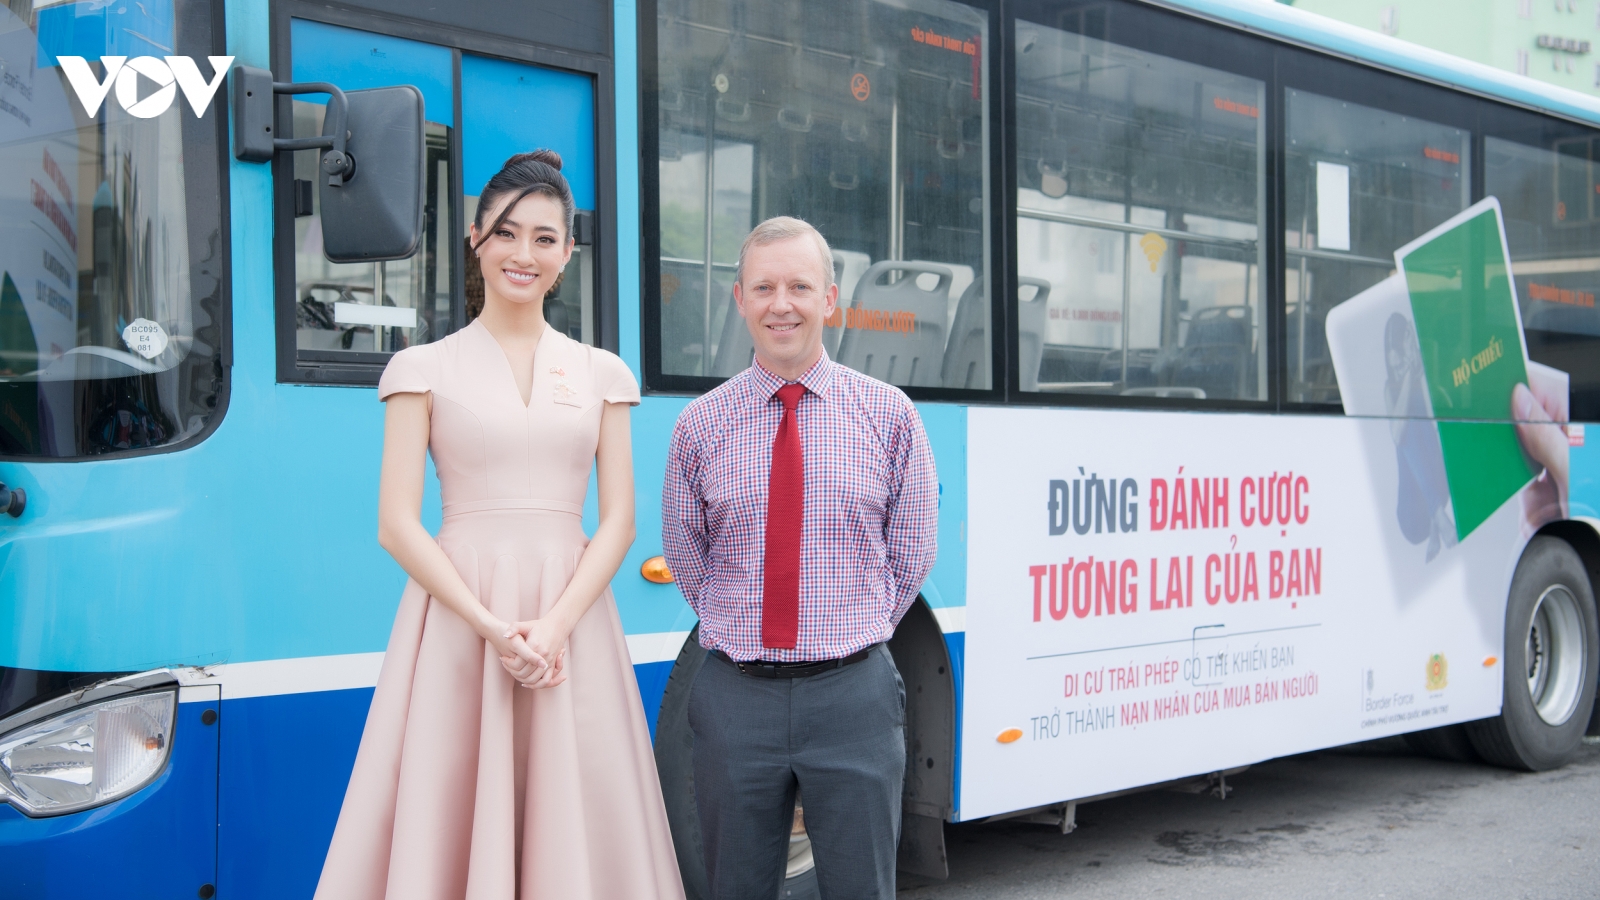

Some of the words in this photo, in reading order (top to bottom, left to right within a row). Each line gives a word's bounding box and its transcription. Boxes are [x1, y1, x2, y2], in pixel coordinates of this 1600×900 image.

[131, 325, 158, 333] BC095
[846, 301, 916, 338] ĐỒNG/LƯỢT
[1452, 358, 1471, 388] HỘ
[1470, 335, 1504, 375] CHIẾU
[1047, 466, 1138, 536] ĐỪNG
[1149, 465, 1229, 532] ĐÁNH
[1239, 471, 1310, 537] CƯỢC
[1029, 555, 1138, 623] TƯƠNG
[1149, 555, 1193, 611] LAI
[1204, 534, 1259, 606] CỦA
[1269, 547, 1322, 609] BẠN
[1064, 673, 1078, 698] DI
[1084, 666, 1104, 695] CƯ
[1108, 660, 1139, 691] TRÁI
[1145, 655, 1179, 687] PHÉP
[1183, 652, 1201, 681] CÓ
[1232, 642, 1267, 674] KHIẾN
[1271, 645, 1294, 672] BẠN
[1030, 706, 1061, 741] TRỞ
[1066, 702, 1115, 735] THÀNH
[1120, 700, 1149, 731] NẠN
[1154, 690, 1189, 721] NHÂN
[1194, 684, 1220, 714] CỦA
[1223, 685, 1250, 709] MUA
[1255, 677, 1278, 704] BÁN
[1282, 670, 1319, 700] NGƯỜI
[1365, 695, 1392, 713] Border
[1393, 693, 1415, 707] Force
